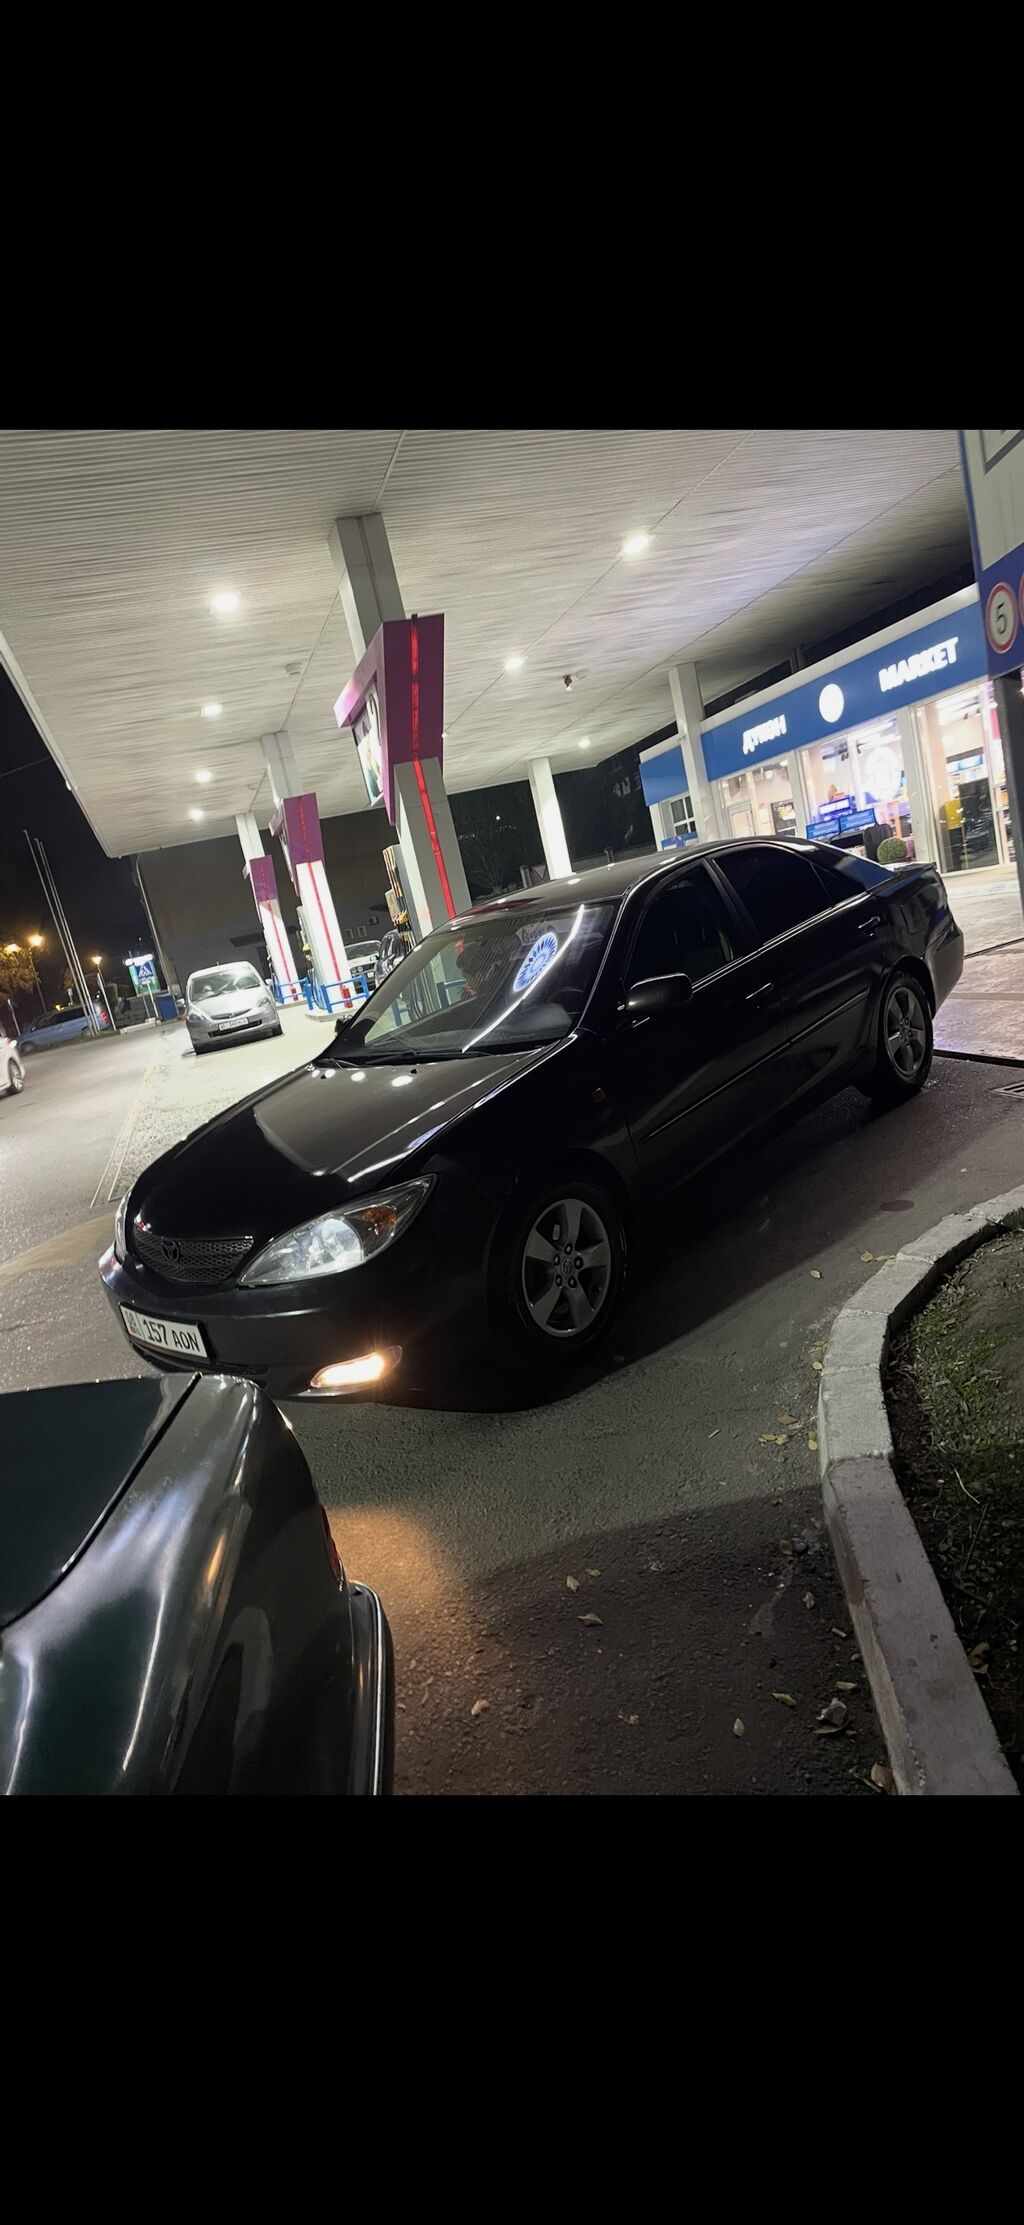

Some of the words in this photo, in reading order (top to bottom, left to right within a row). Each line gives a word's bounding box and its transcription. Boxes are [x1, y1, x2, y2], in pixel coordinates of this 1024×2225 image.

[996, 602, 1007, 635] 5
[879, 636, 959, 692] MARKET
[143, 1319, 168, 1346] 157
[171, 1330, 200, 1353] AON
